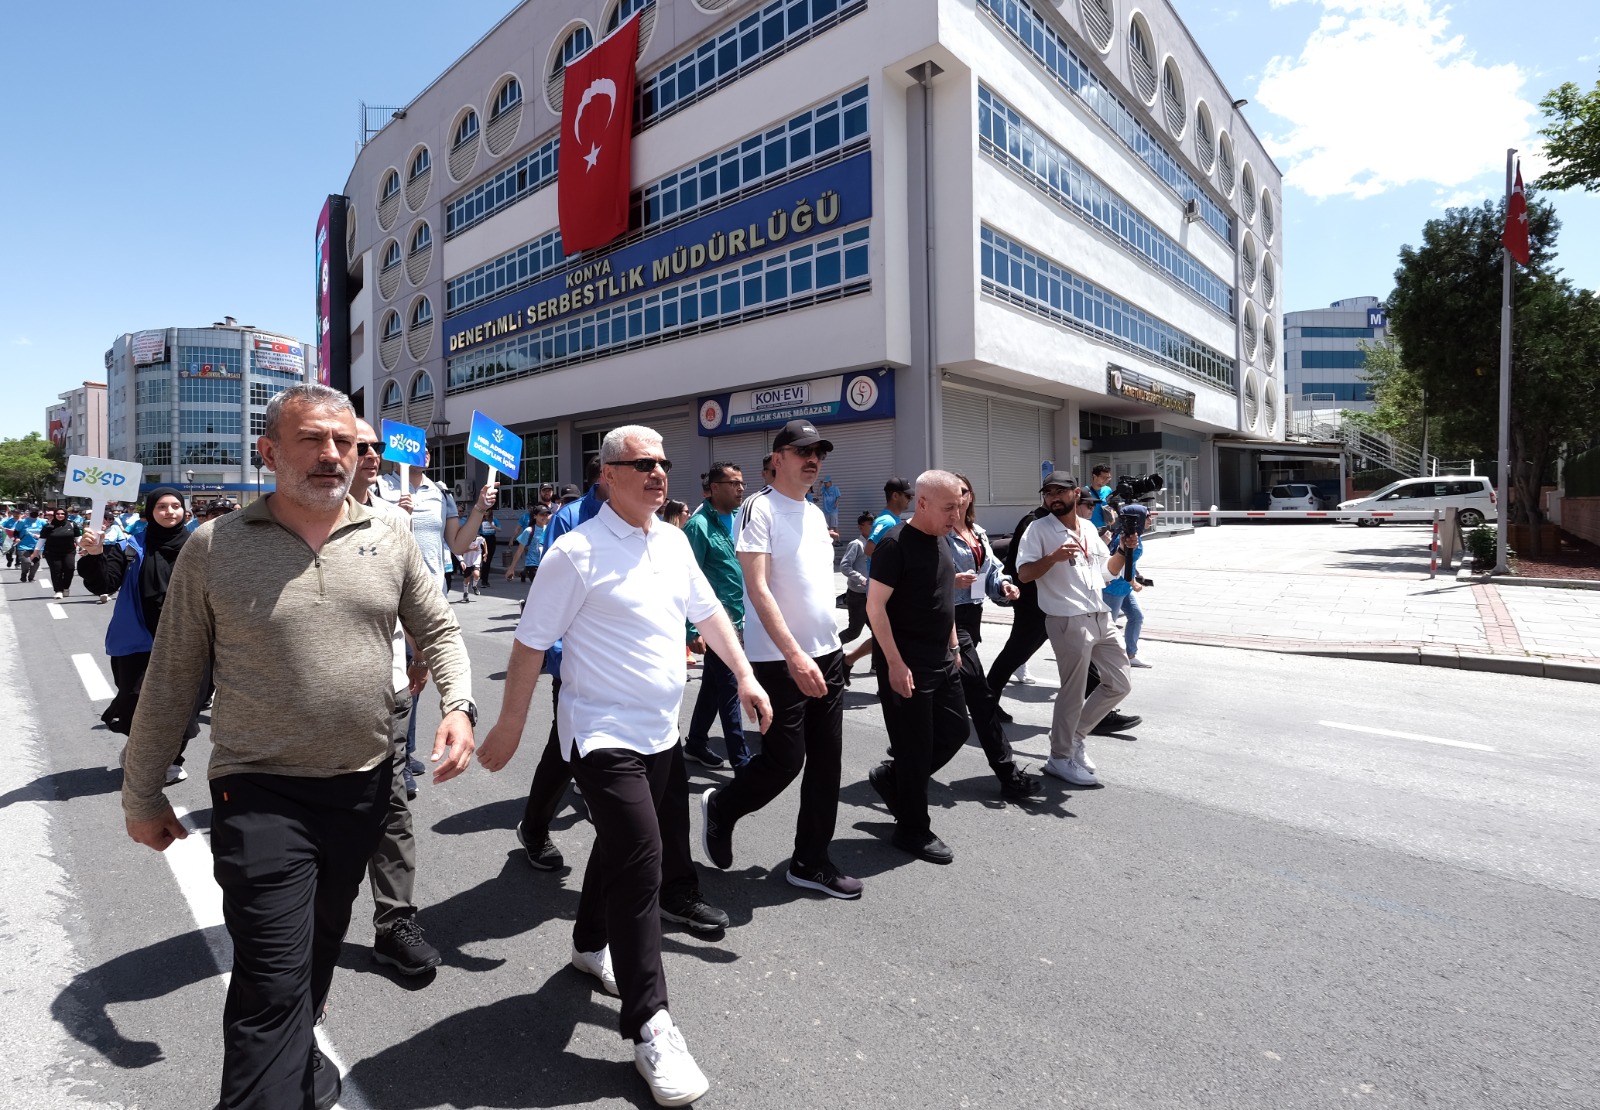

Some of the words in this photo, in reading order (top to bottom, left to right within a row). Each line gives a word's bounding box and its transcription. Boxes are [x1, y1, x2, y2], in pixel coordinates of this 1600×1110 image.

[652, 189, 841, 282] MÜDÜRLÜĞÜ
[566, 258, 611, 288] KONYA
[734, 415, 755, 425] HALKA
[755, 413, 772, 423] AÇIK
[772, 410, 793, 420] SATIŞ
[792, 405, 832, 417] MAĞAZASI
